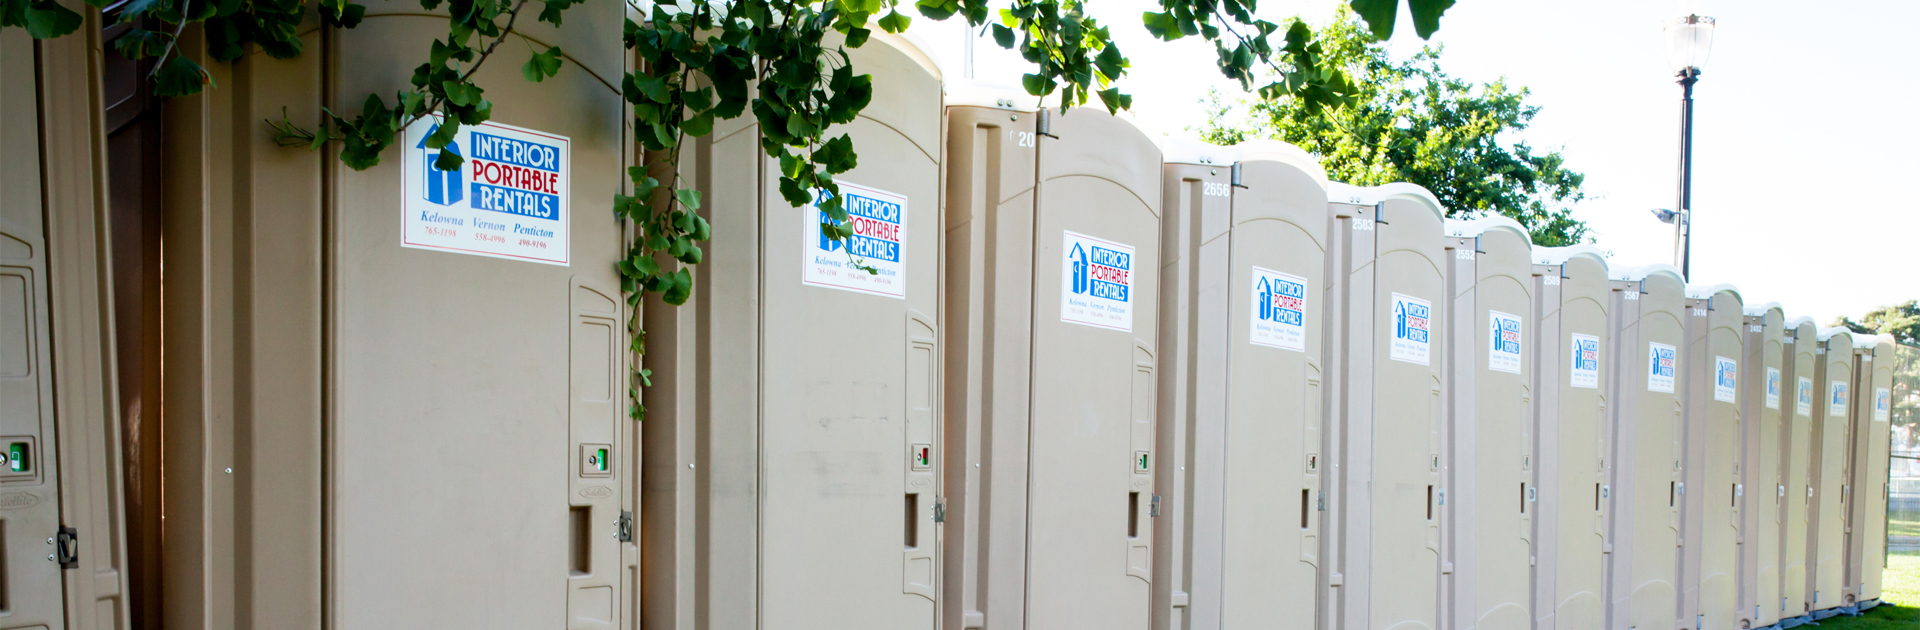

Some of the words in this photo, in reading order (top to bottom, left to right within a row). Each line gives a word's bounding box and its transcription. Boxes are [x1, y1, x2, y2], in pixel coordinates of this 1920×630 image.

[475, 134, 554, 169] INTERIOR
[472, 160, 558, 194] PORTABLE
[1204, 182, 1229, 197] 2656
[480, 186, 550, 217] RENTALS
[850, 195, 897, 222] INTERIOR
[421, 211, 464, 226] Kelowna
[473, 218, 505, 231] Vernon
[514, 223, 553, 238] Penticton
[1352, 218, 1373, 230] 2583
[425, 226, 457, 237] 765-1198
[475, 233, 505, 243] 558-4996
[519, 239, 546, 249] 490-9196
[852, 235, 894, 260] RENTALS
[815, 256, 841, 267] Kelowna
[1093, 247, 1128, 269] INTERIOR
[1456, 249, 1474, 260] 2552
[1092, 264, 1128, 285] PORTABLE
[1544, 276, 1560, 285] 2589
[1094, 280, 1125, 300] RENTALS
[1276, 280, 1302, 298] INTERIOR
[1274, 294, 1302, 311] PORTABLE
[1276, 308, 1300, 325] RENTALS
